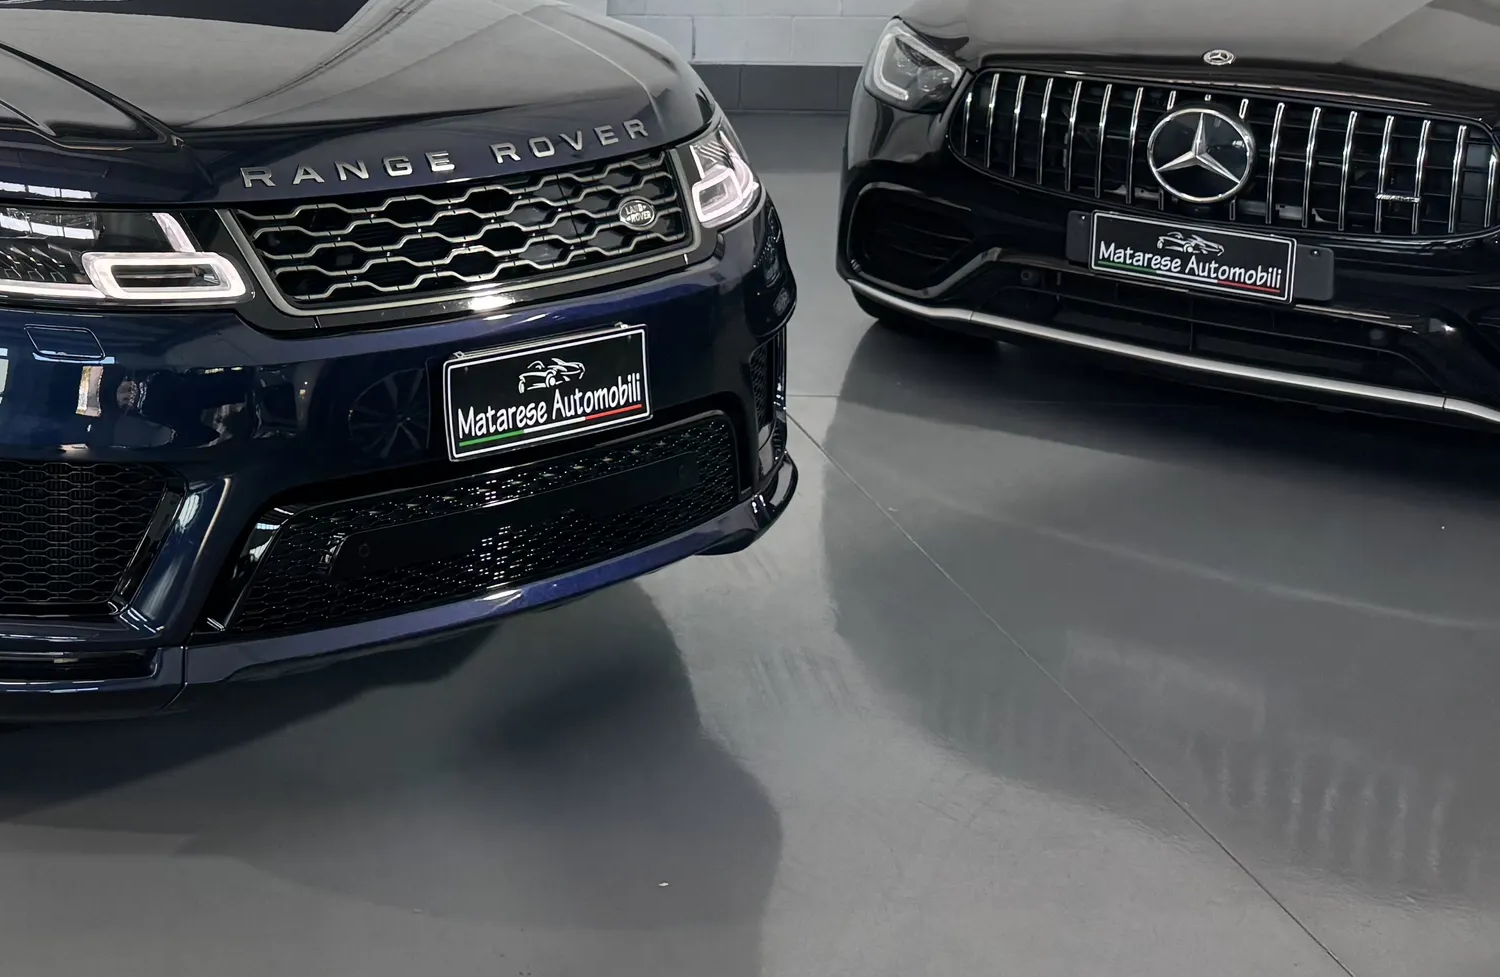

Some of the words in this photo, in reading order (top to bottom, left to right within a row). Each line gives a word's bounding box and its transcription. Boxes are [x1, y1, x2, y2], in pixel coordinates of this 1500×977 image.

[240, 150, 455, 188] RANGE
[489, 118, 649, 164] ROVER
[1099, 240, 1182, 273] Matarese
[1184, 254, 1282, 289] Automobili
[457, 400, 548, 439] Matarese
[551, 371, 641, 420] Automobili
